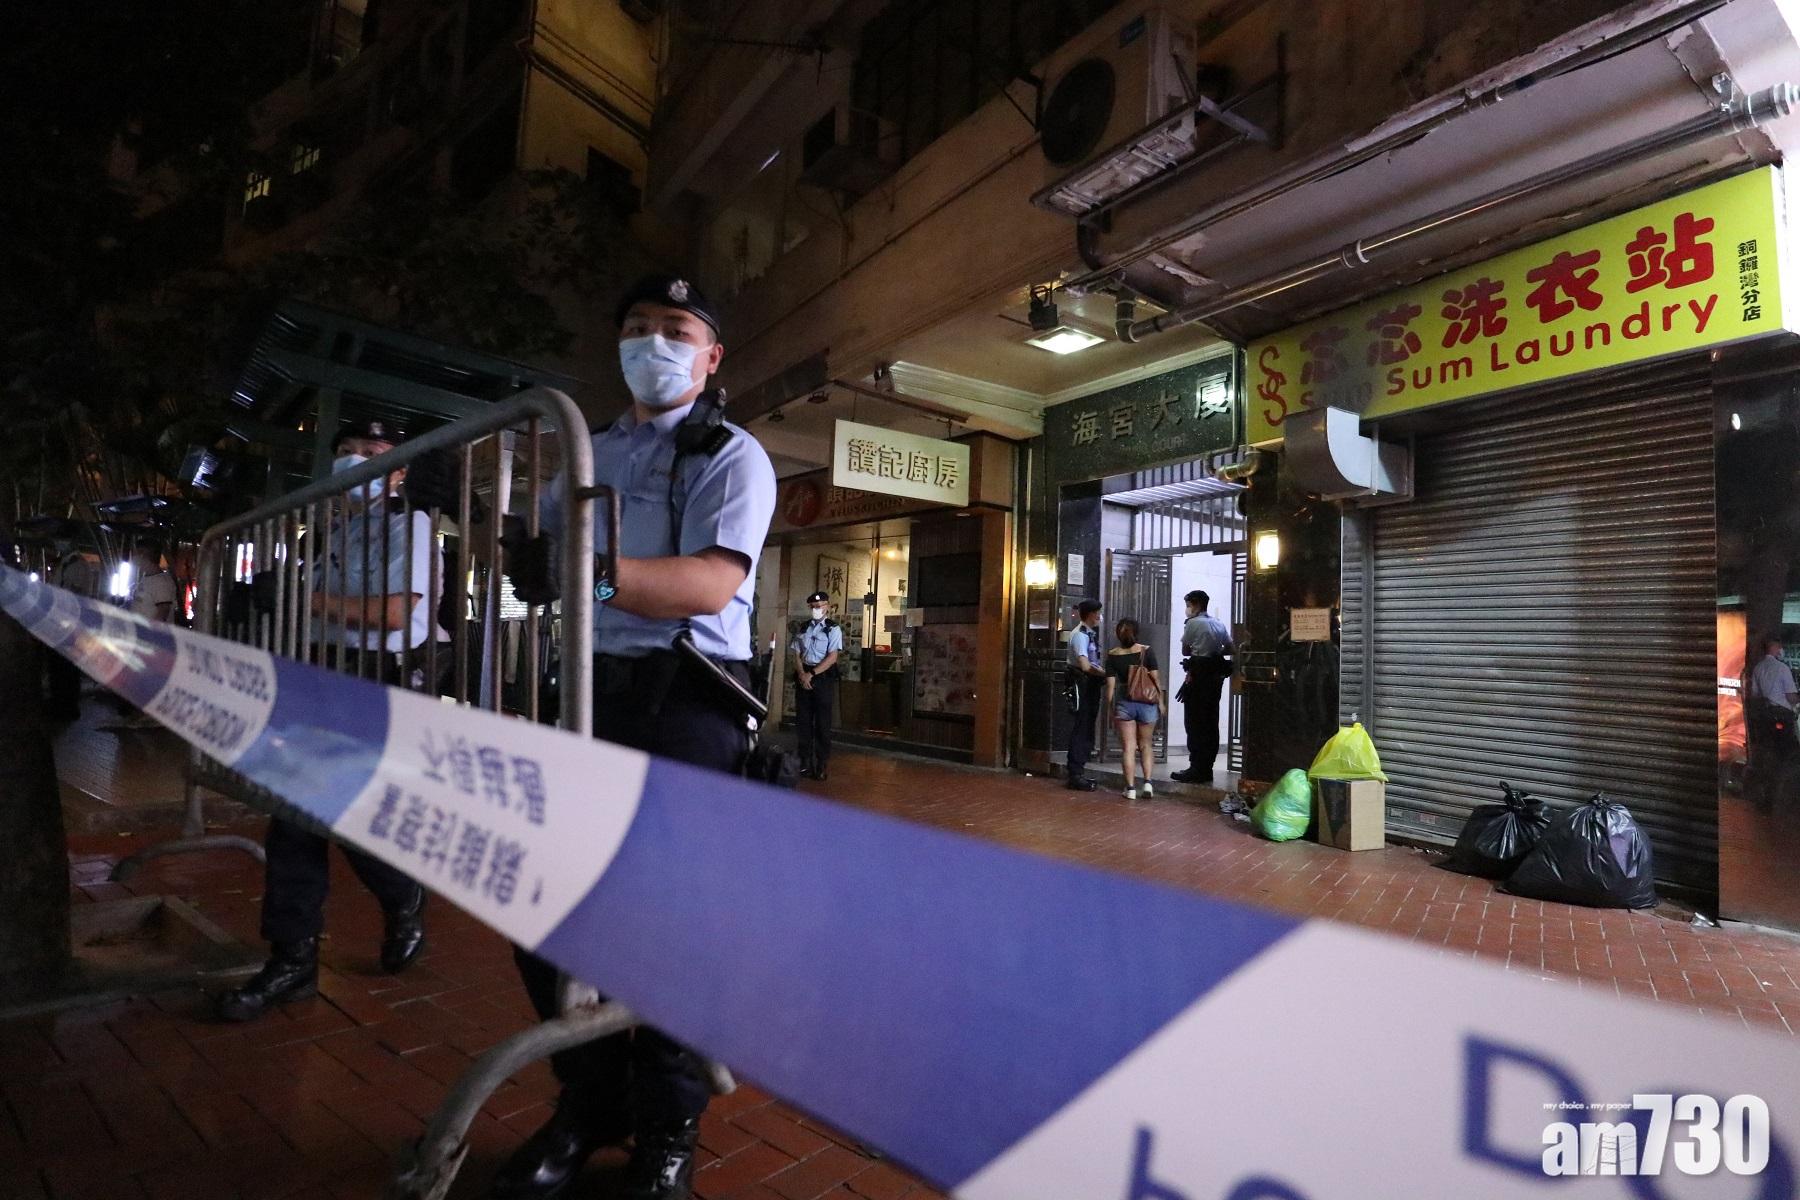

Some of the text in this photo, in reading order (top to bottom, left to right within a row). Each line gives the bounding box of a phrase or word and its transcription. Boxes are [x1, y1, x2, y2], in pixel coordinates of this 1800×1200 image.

[1737, 239, 1761, 322] 銅鑼灣分店
[1386, 356, 1473, 396] Sum
[1490, 294, 1718, 372] Laundry
